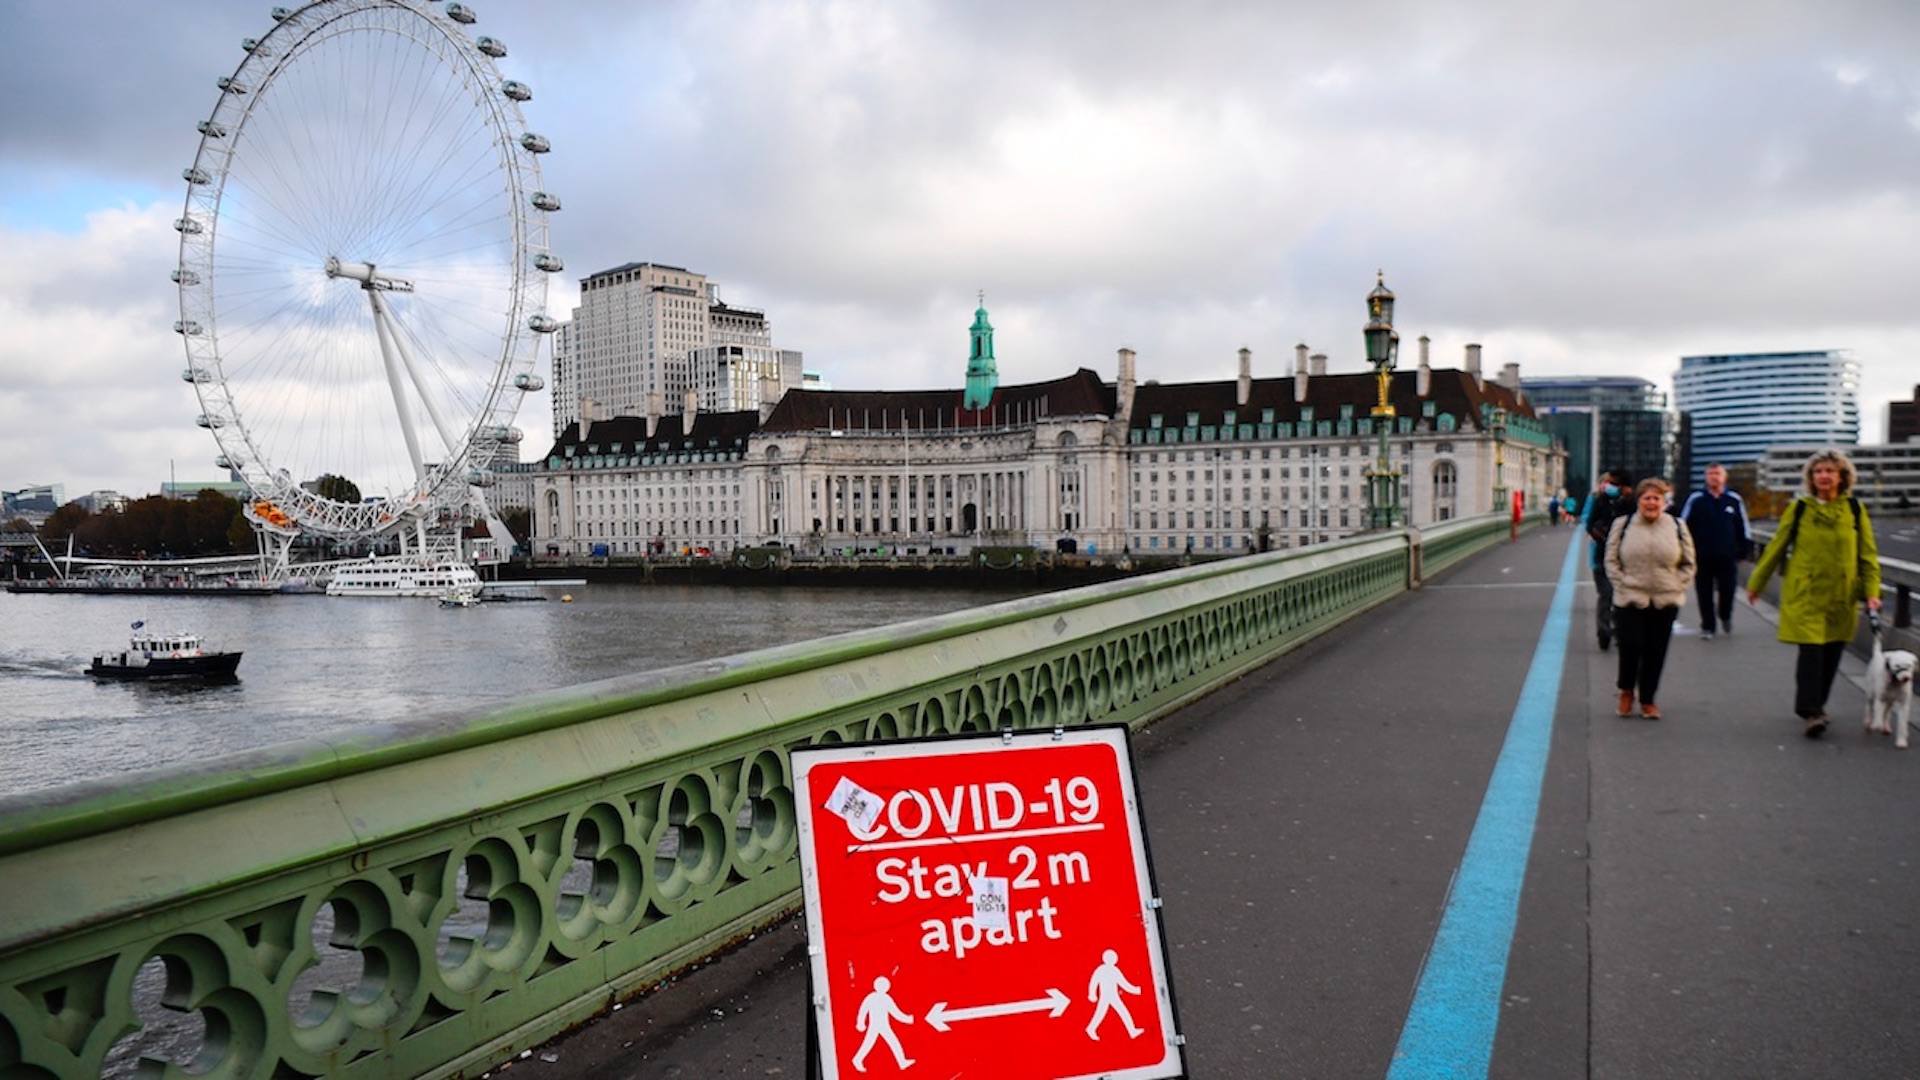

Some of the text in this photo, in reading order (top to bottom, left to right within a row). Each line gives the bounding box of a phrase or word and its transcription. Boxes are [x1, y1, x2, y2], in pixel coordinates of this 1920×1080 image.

[877, 857, 987, 904] Stay
[980, 893, 1002, 904] CON
[921, 896, 1062, 959] apart
